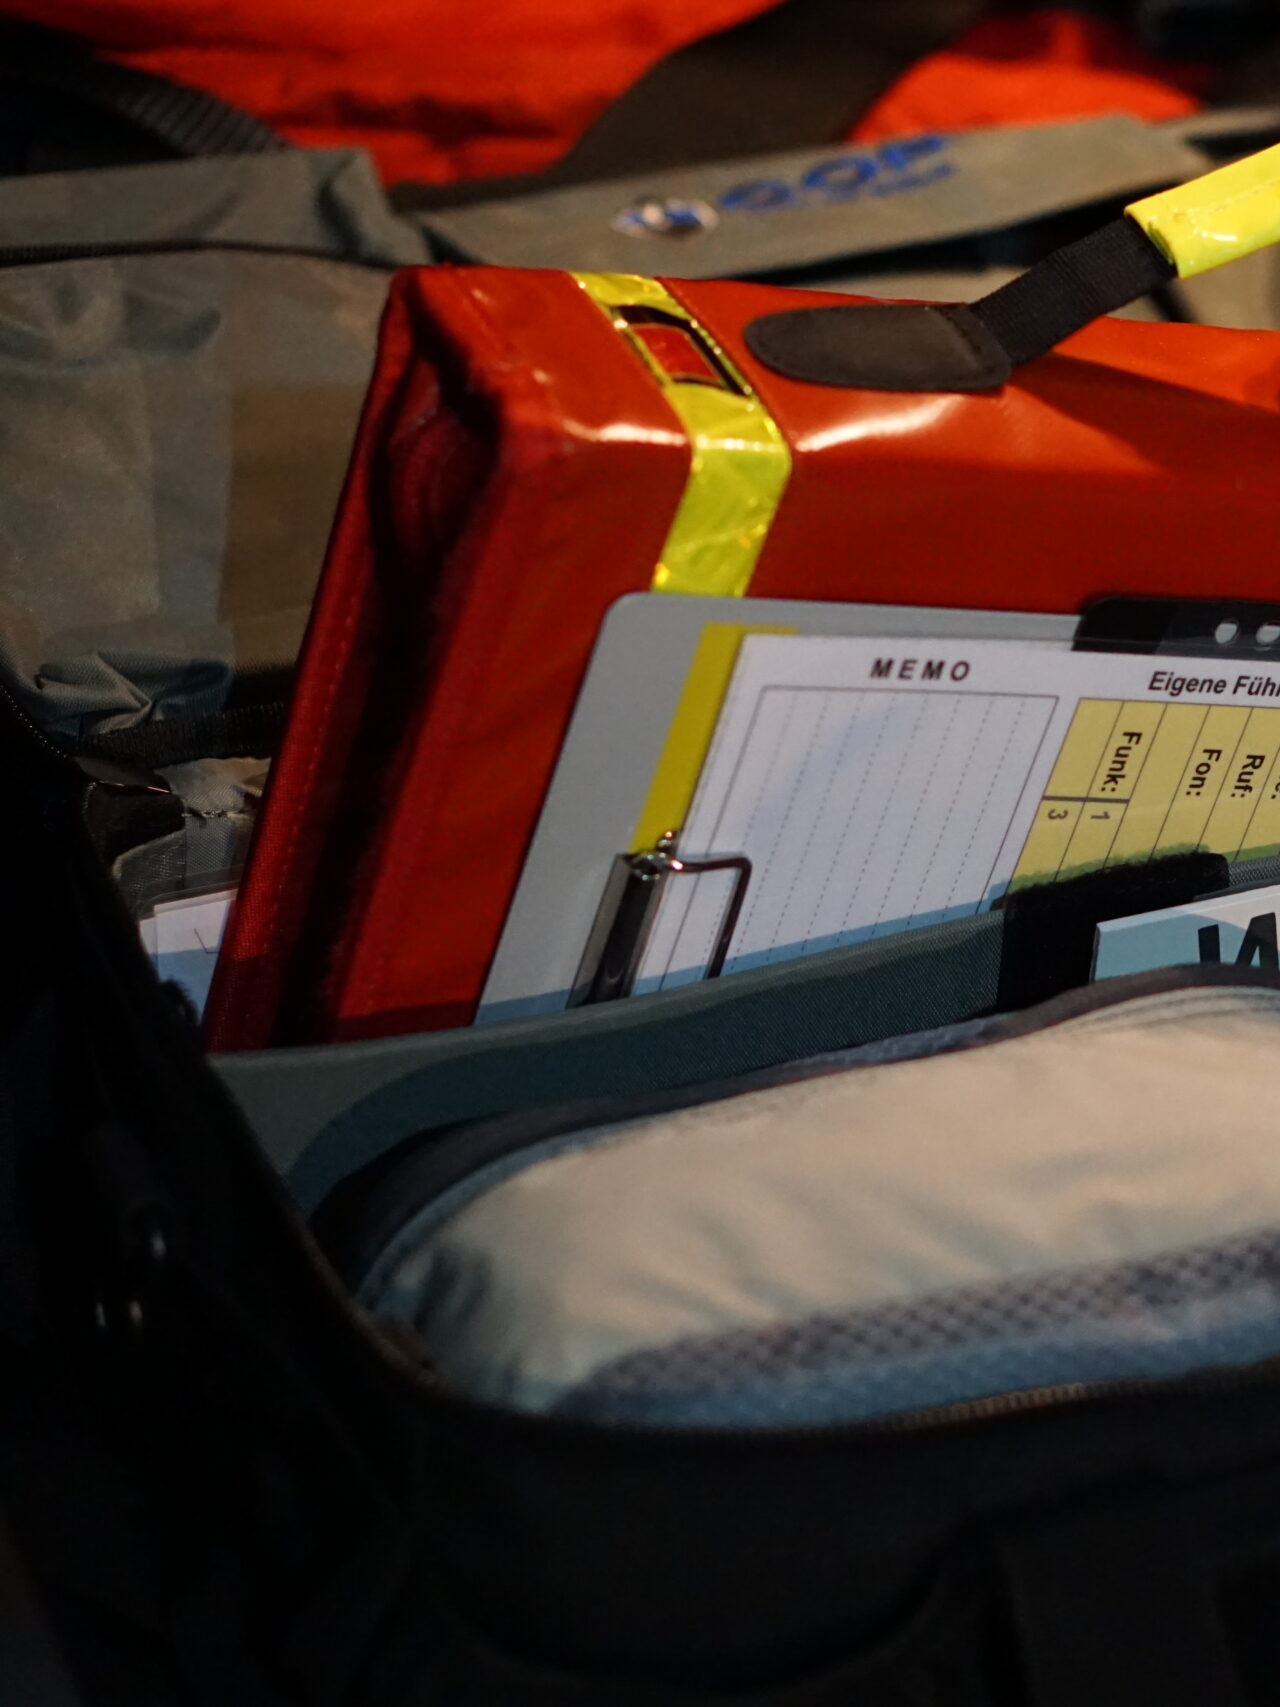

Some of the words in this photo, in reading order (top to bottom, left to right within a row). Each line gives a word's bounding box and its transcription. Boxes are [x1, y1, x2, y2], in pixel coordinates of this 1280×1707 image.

[869, 657, 971, 682] MEMO
[1148, 670, 1227, 697] Eigene
[1100, 731, 1143, 793] Funk:
[1185, 748, 1223, 797] Fon:
[1230, 754, 1266, 799] Ruf:
[1047, 808, 1068, 820] 3
